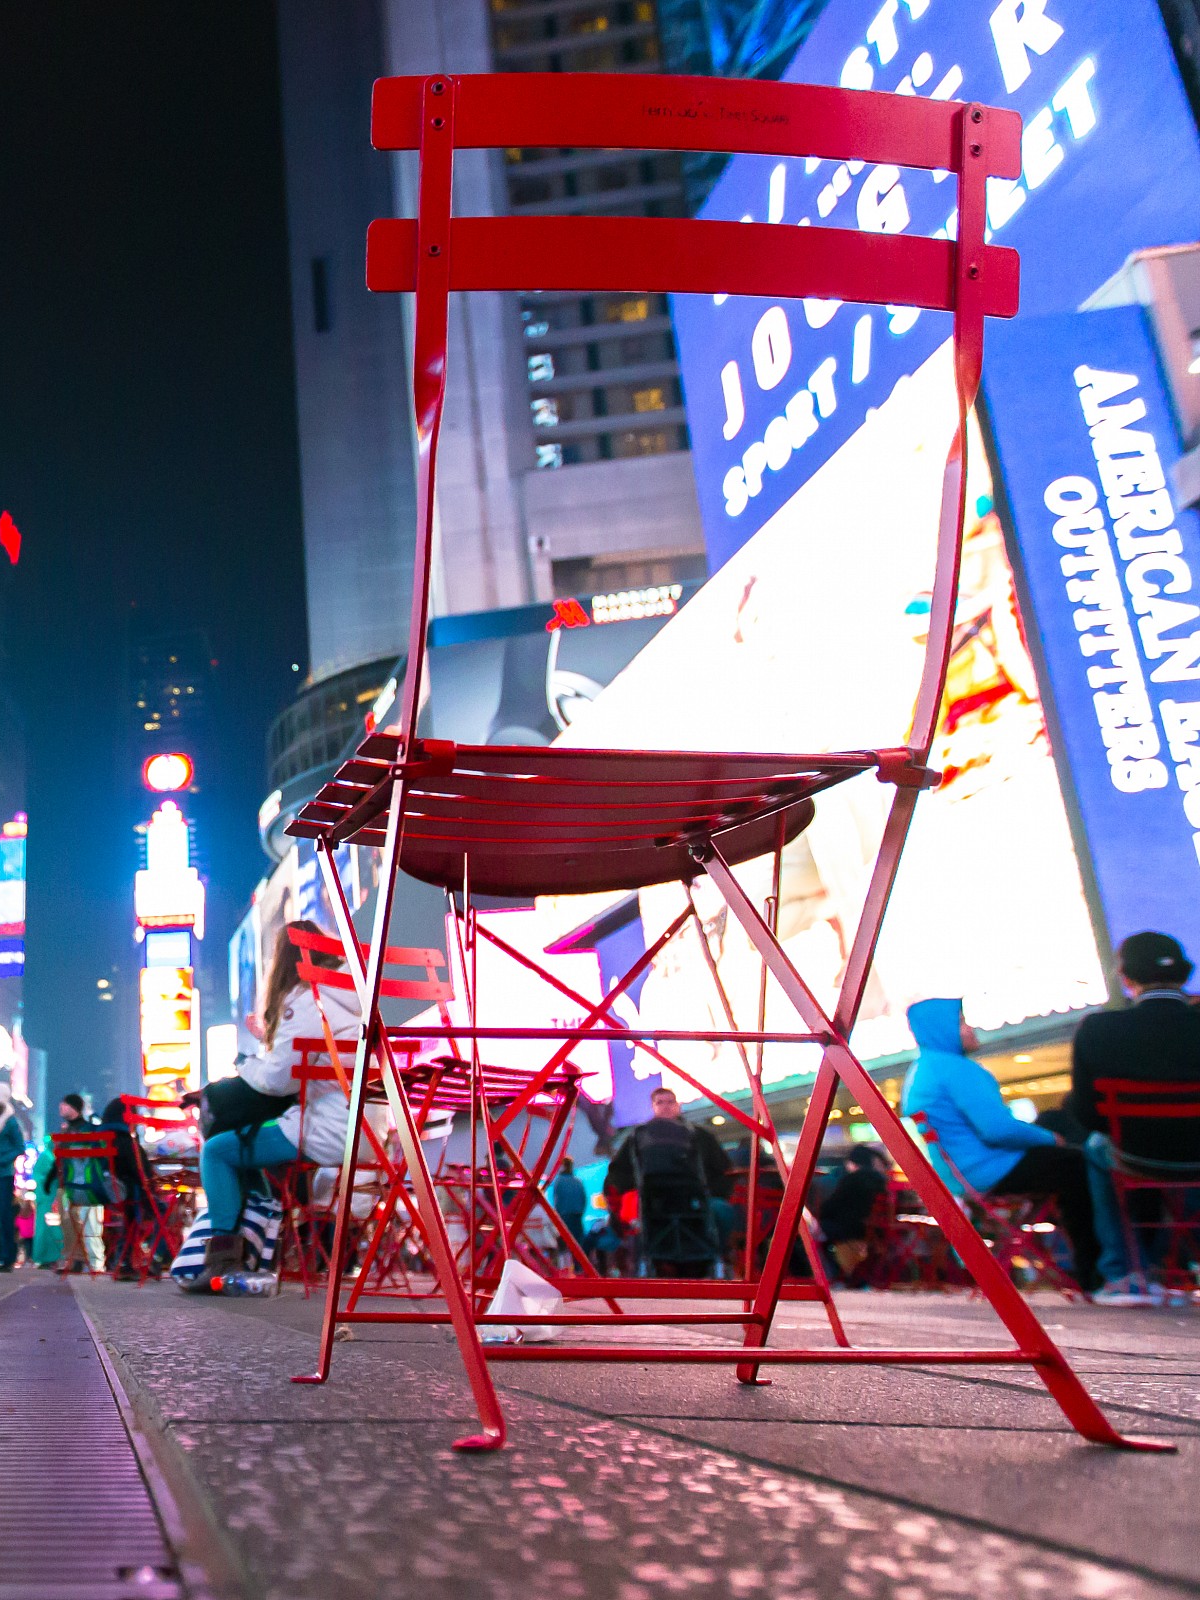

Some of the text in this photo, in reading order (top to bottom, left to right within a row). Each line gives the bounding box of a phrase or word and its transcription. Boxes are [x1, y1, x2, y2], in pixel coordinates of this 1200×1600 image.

[723, 357, 837, 517] SPORT
[1073, 363, 1200, 685] AMERICAN
[1043, 474, 1169, 795] OUTFITTERS
